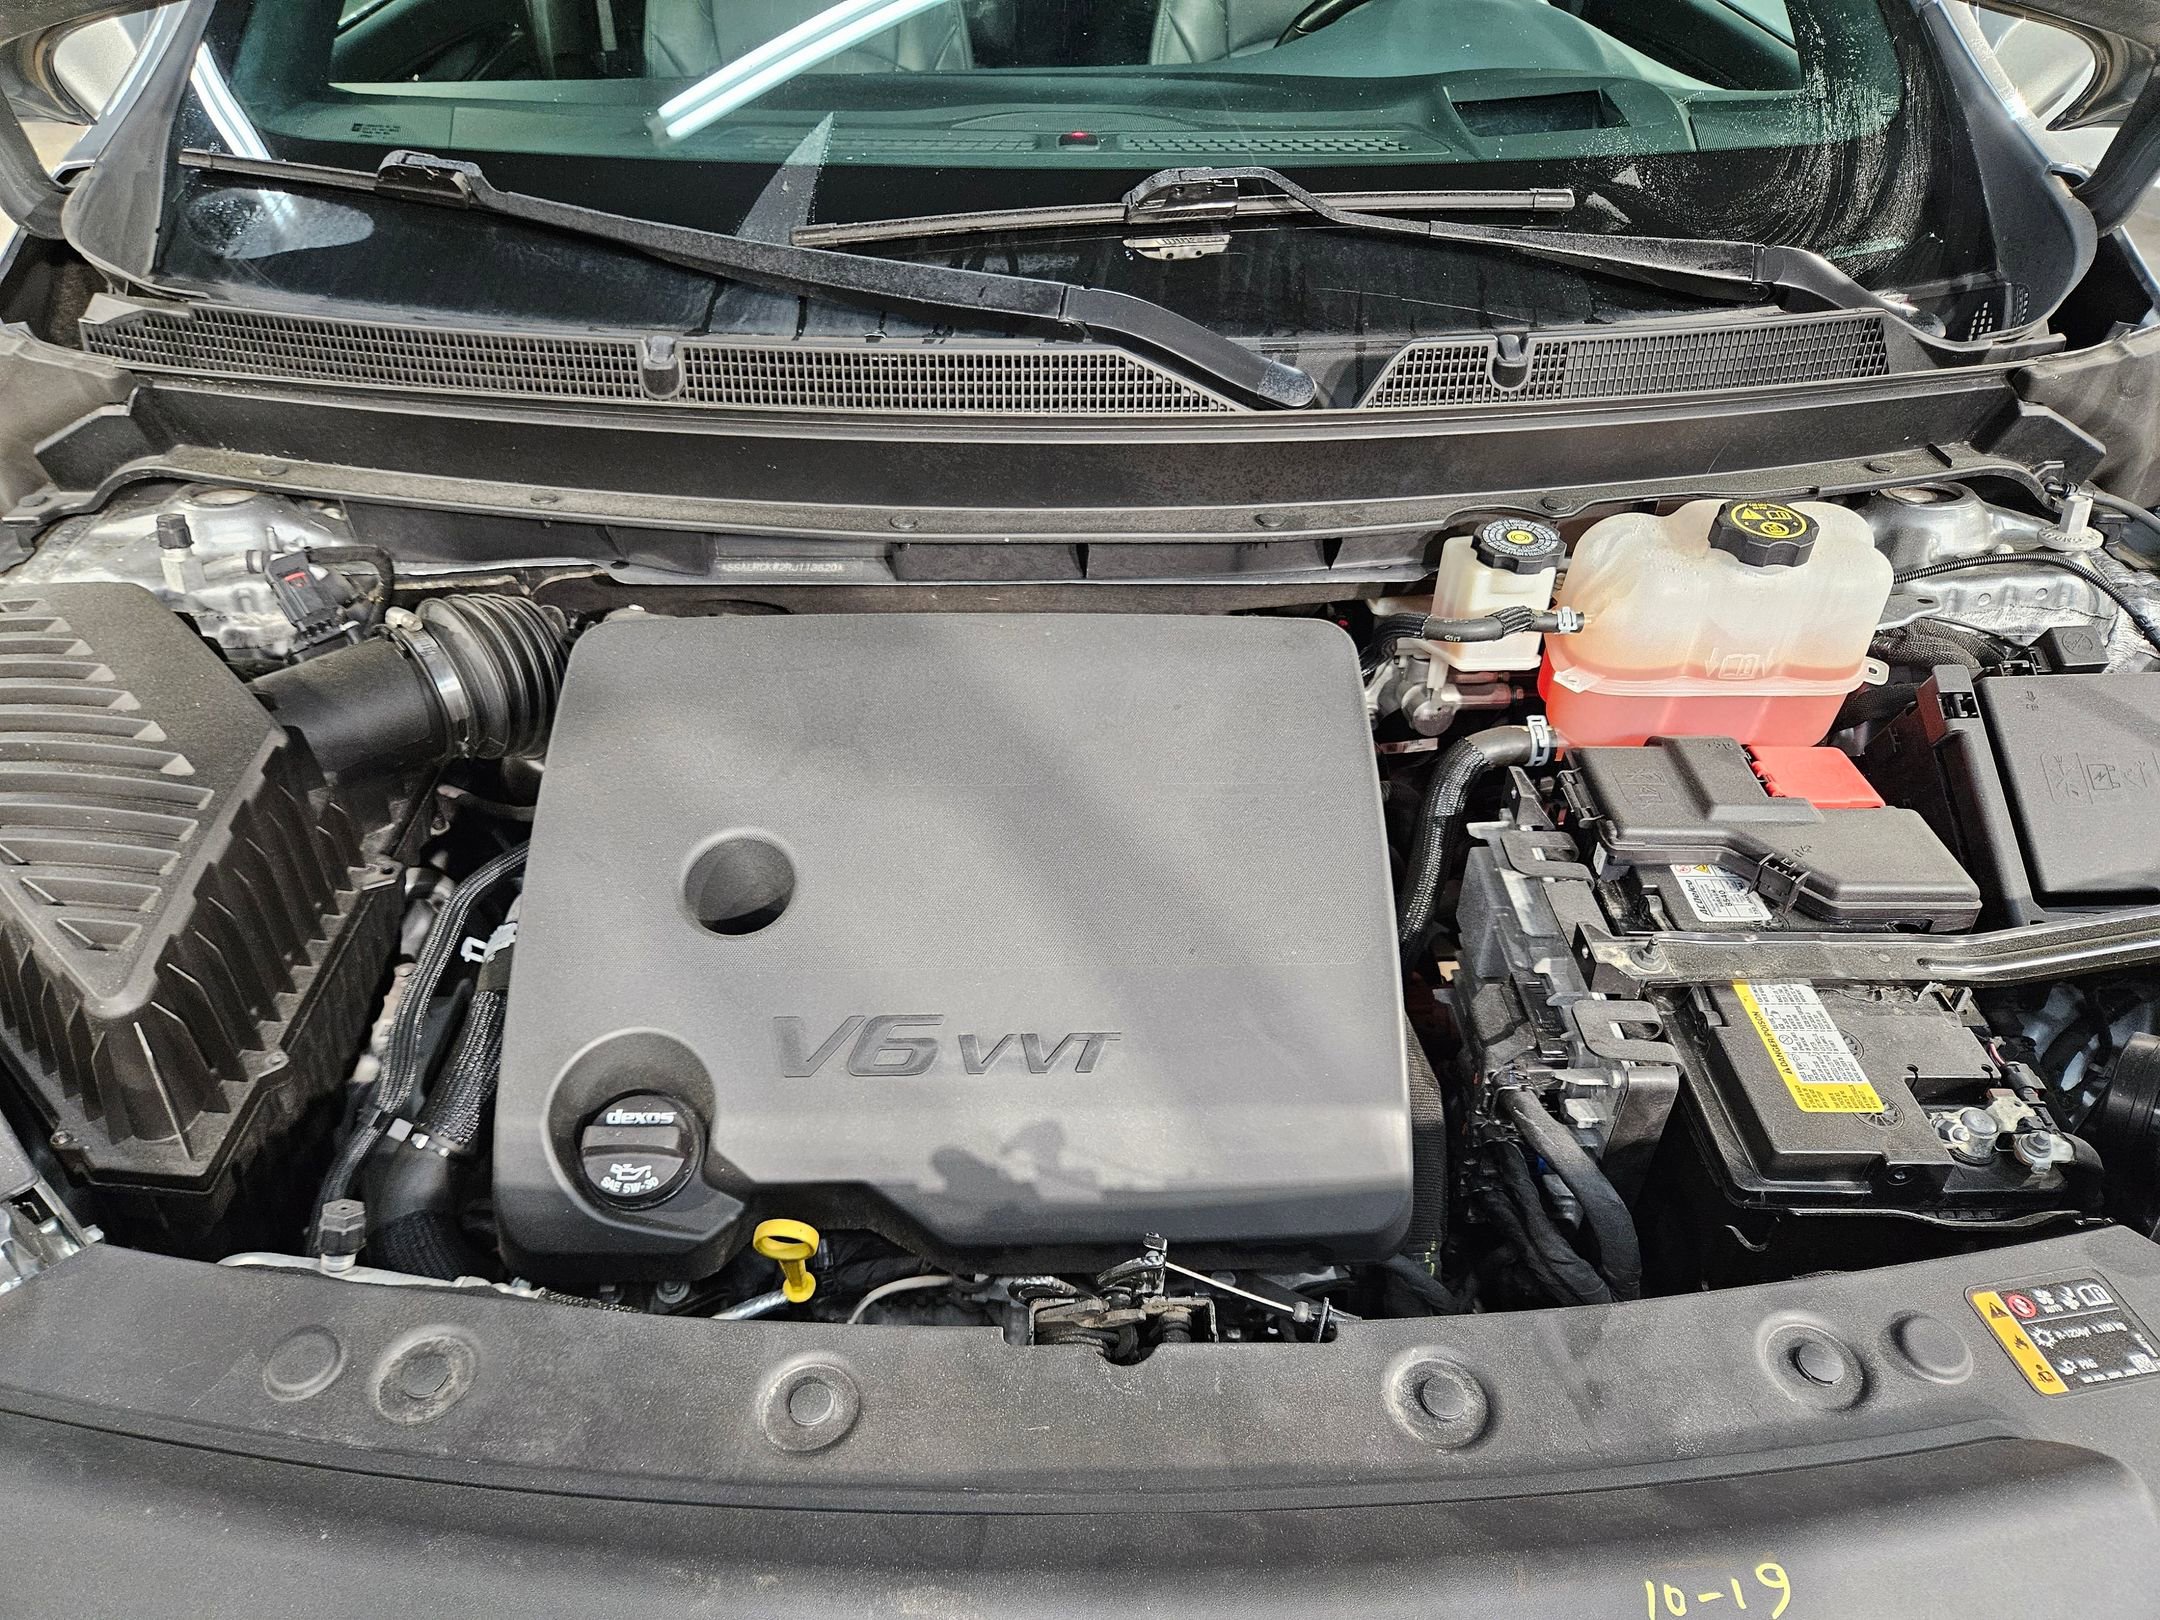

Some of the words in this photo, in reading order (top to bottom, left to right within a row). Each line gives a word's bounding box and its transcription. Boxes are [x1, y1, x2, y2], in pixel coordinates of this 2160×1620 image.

[1685, 879, 1709, 916] ACDelco
[1752, 1010, 1771, 1038] POISON
[773, 1014, 944, 1078] V6
[957, 1031, 1122, 1075] VVT
[1767, 1037, 1788, 1071] DANGER
[605, 1109, 677, 1125] dexos
[600, 1176, 622, 1193] SAE
[622, 1176, 659, 1193] 5W-30
[2044, 1304, 2064, 1314] AUTO
[2054, 1327, 2092, 1340] R-1234yf
[2113, 1321, 2128, 1332] kg
[2078, 1358, 2099, 1370] PAG
[1645, 1563, 1791, 1620] 10-19
